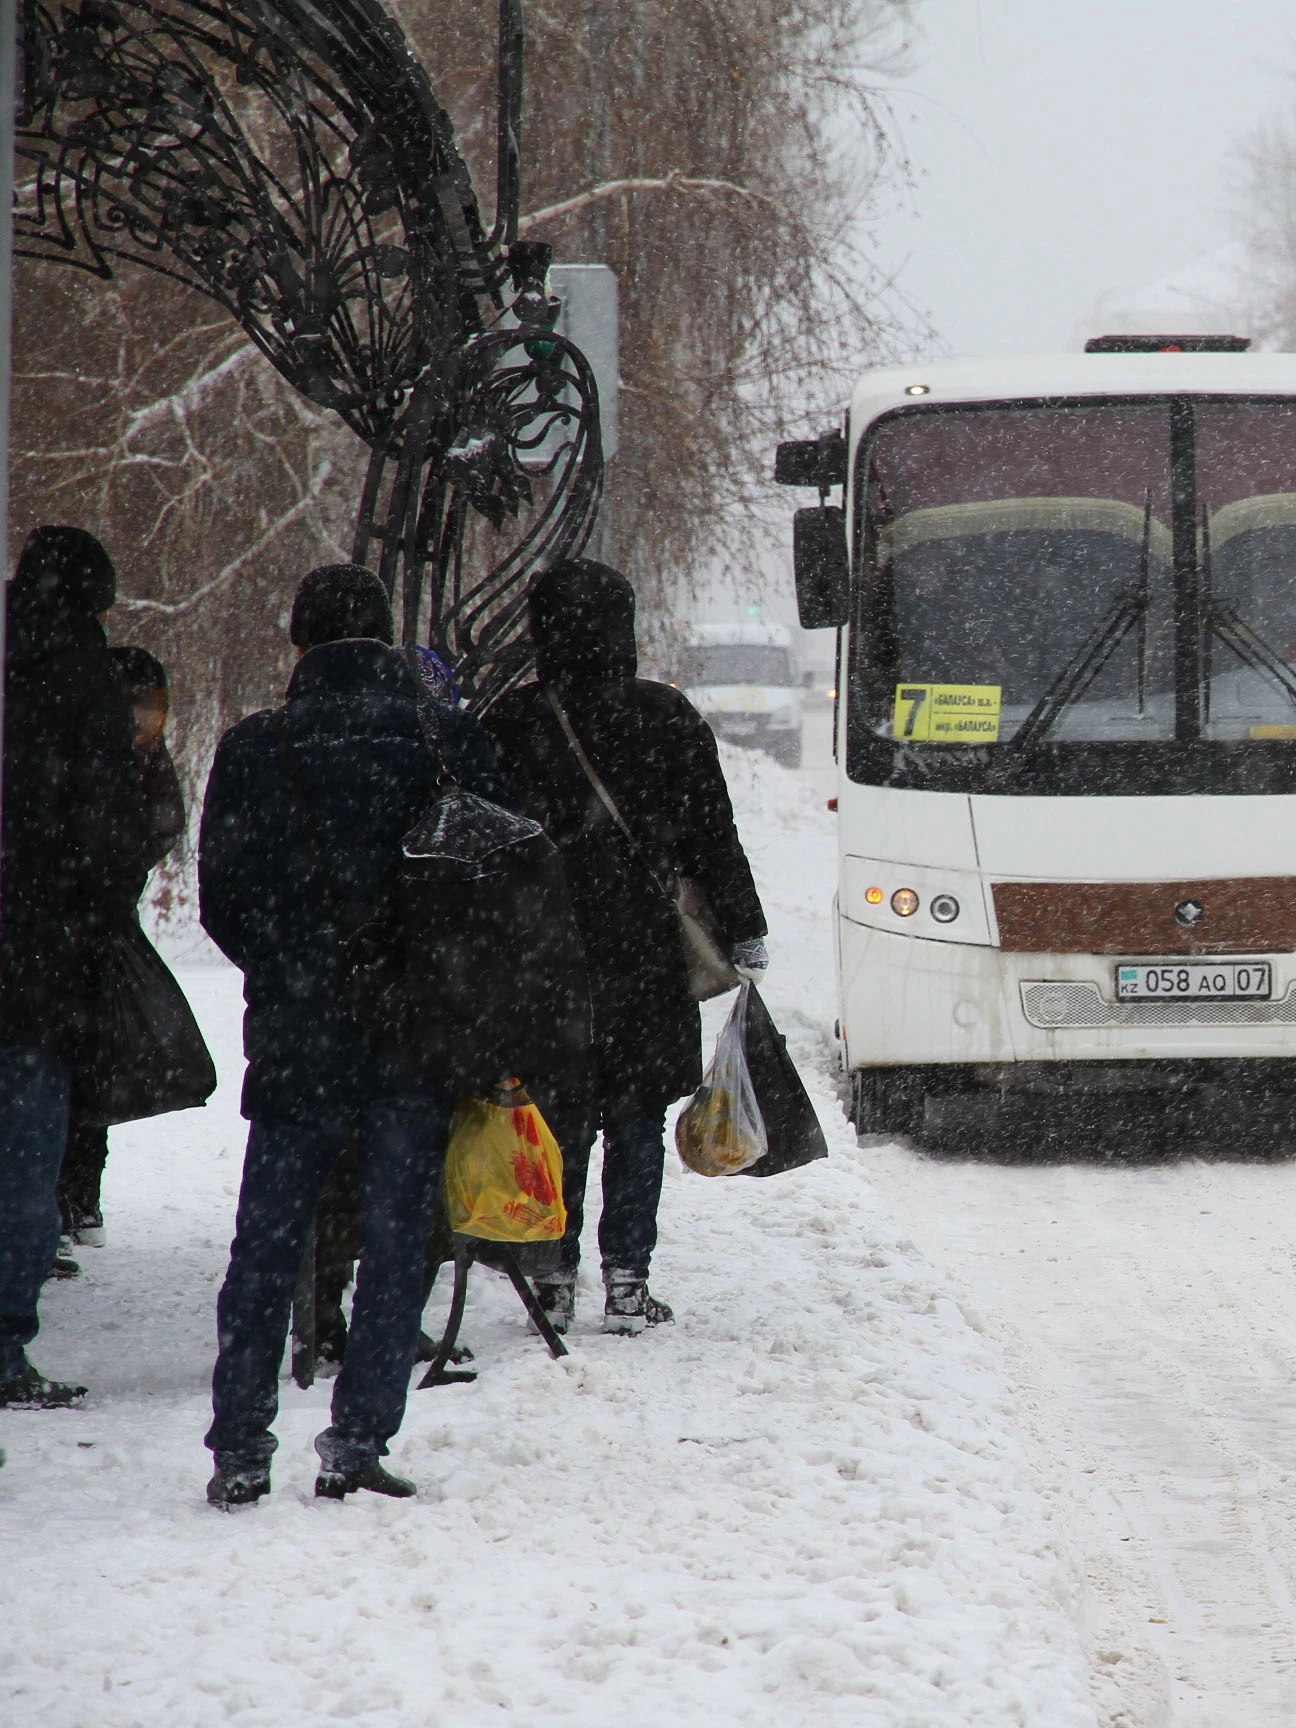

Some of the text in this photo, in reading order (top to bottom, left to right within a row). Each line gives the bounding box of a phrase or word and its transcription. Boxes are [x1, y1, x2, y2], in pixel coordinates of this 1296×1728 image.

[900, 689, 926, 736] 7
[1121, 983, 1138, 993] KZ
[1145, 968, 1266, 993] 058 AQ 07
